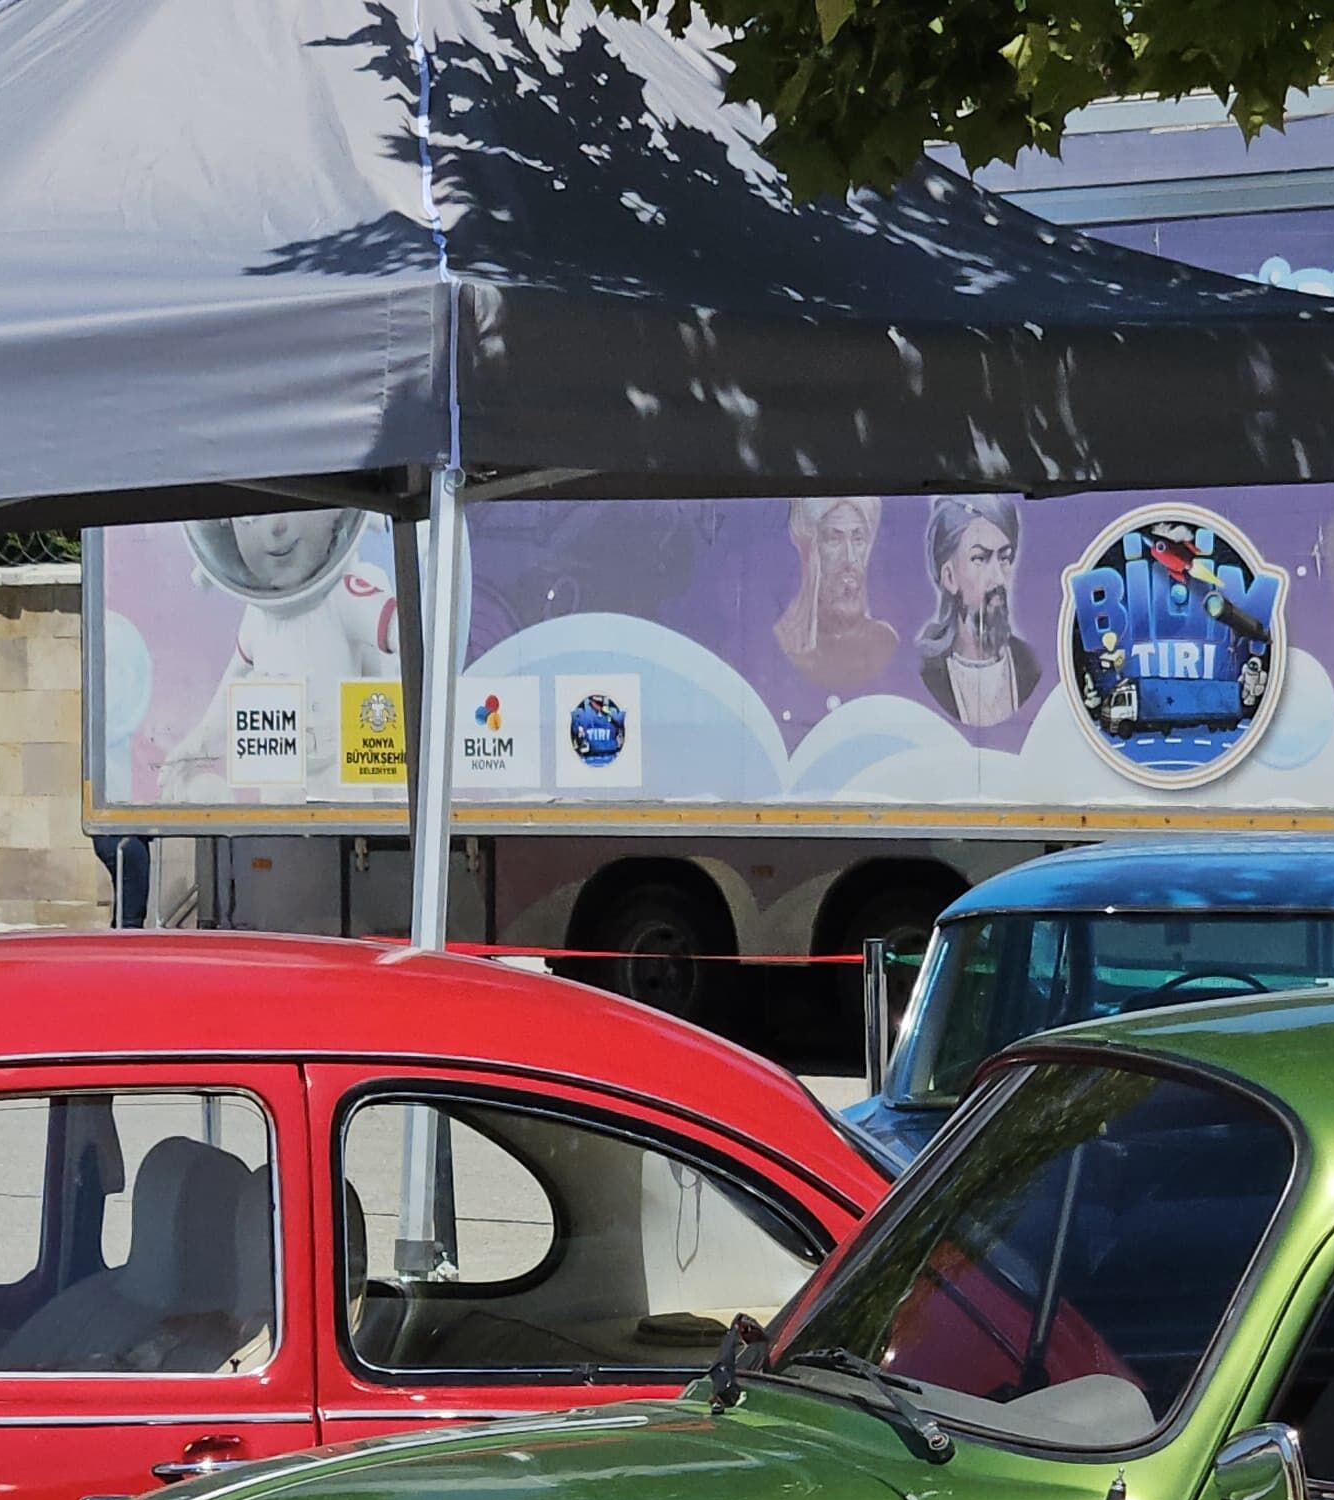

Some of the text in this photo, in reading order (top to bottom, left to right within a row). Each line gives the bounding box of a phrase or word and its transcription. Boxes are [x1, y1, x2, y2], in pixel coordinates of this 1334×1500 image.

[1131, 642, 1217, 681] TIRI
[236, 709, 297, 732] BENİM
[362, 737, 395, 749] KONYA
[586, 728, 611, 741] TIRI
[236, 736, 297, 759] ŞEHRİM
[464, 737, 514, 757] BİLİM
[472, 759, 506, 770] KONYA
